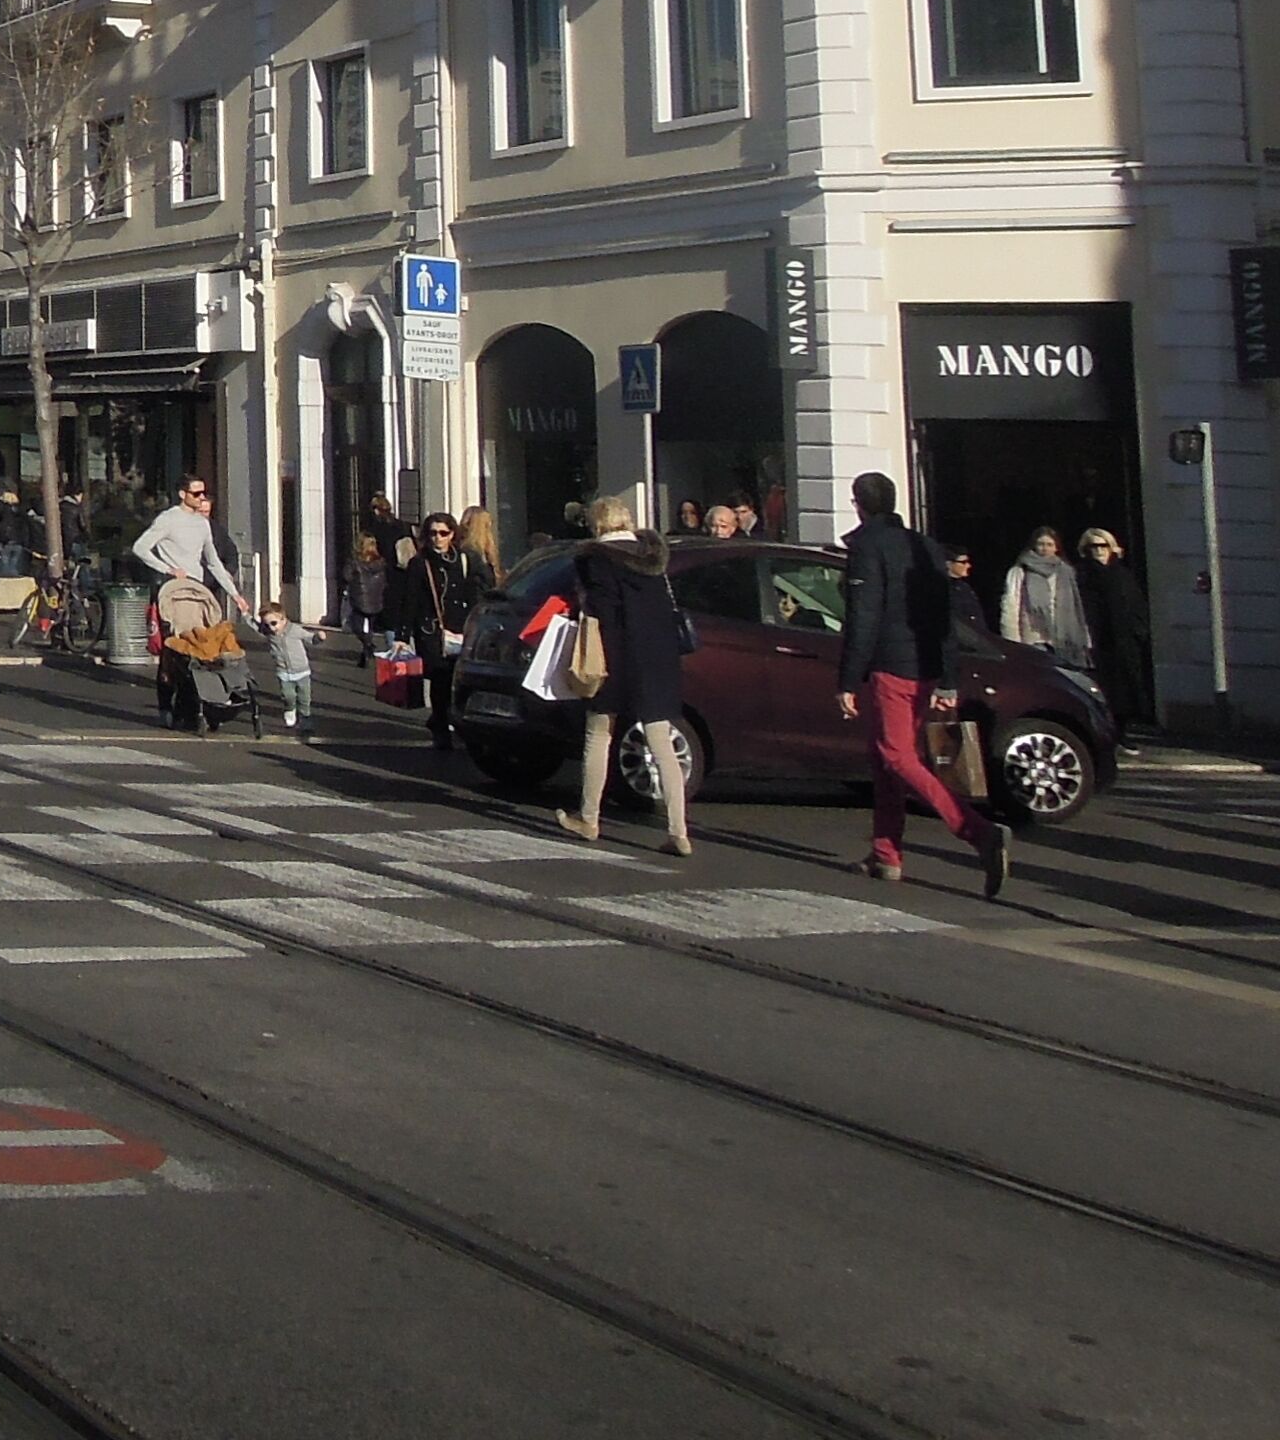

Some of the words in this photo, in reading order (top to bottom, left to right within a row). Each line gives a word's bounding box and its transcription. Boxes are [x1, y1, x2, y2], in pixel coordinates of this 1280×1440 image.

[422, 319, 442, 329] SAUF
[785, 260, 809, 356] MANGO
[1242, 261, 1266, 363] MANGO
[937, 344, 1094, 378] MANGO
[508, 407, 576, 432] MANGO
